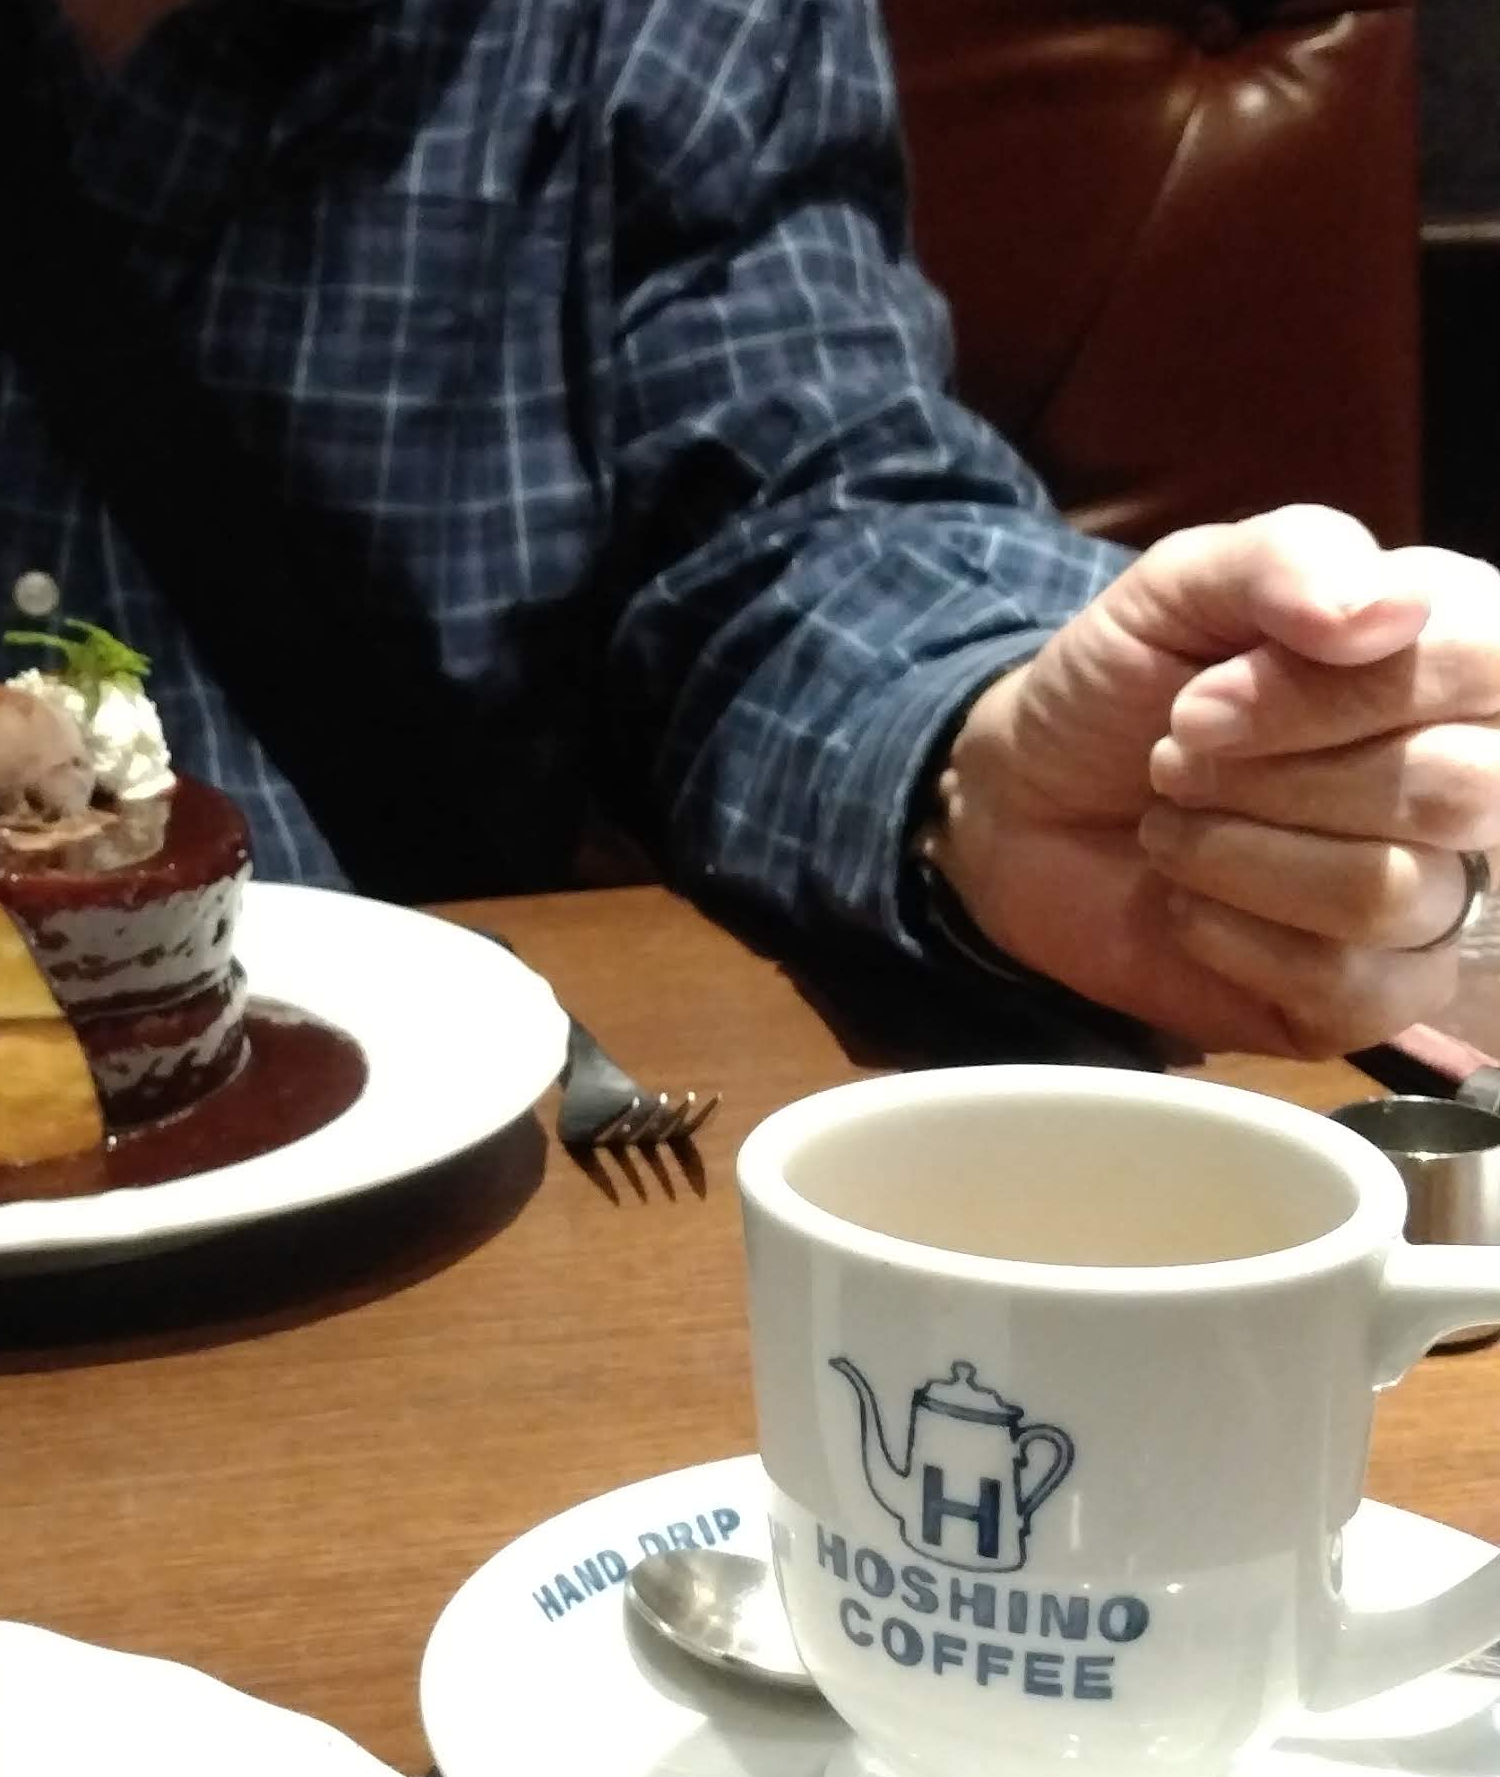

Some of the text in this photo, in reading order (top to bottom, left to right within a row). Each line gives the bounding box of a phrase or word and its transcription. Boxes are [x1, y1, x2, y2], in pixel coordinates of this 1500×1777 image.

[532, 1507, 741, 1623] HAND DRIP
[921, 1462, 1001, 1559] H
[816, 1523, 1150, 1643] HOSHINO
[839, 1597, 1115, 1700] COFFEE
